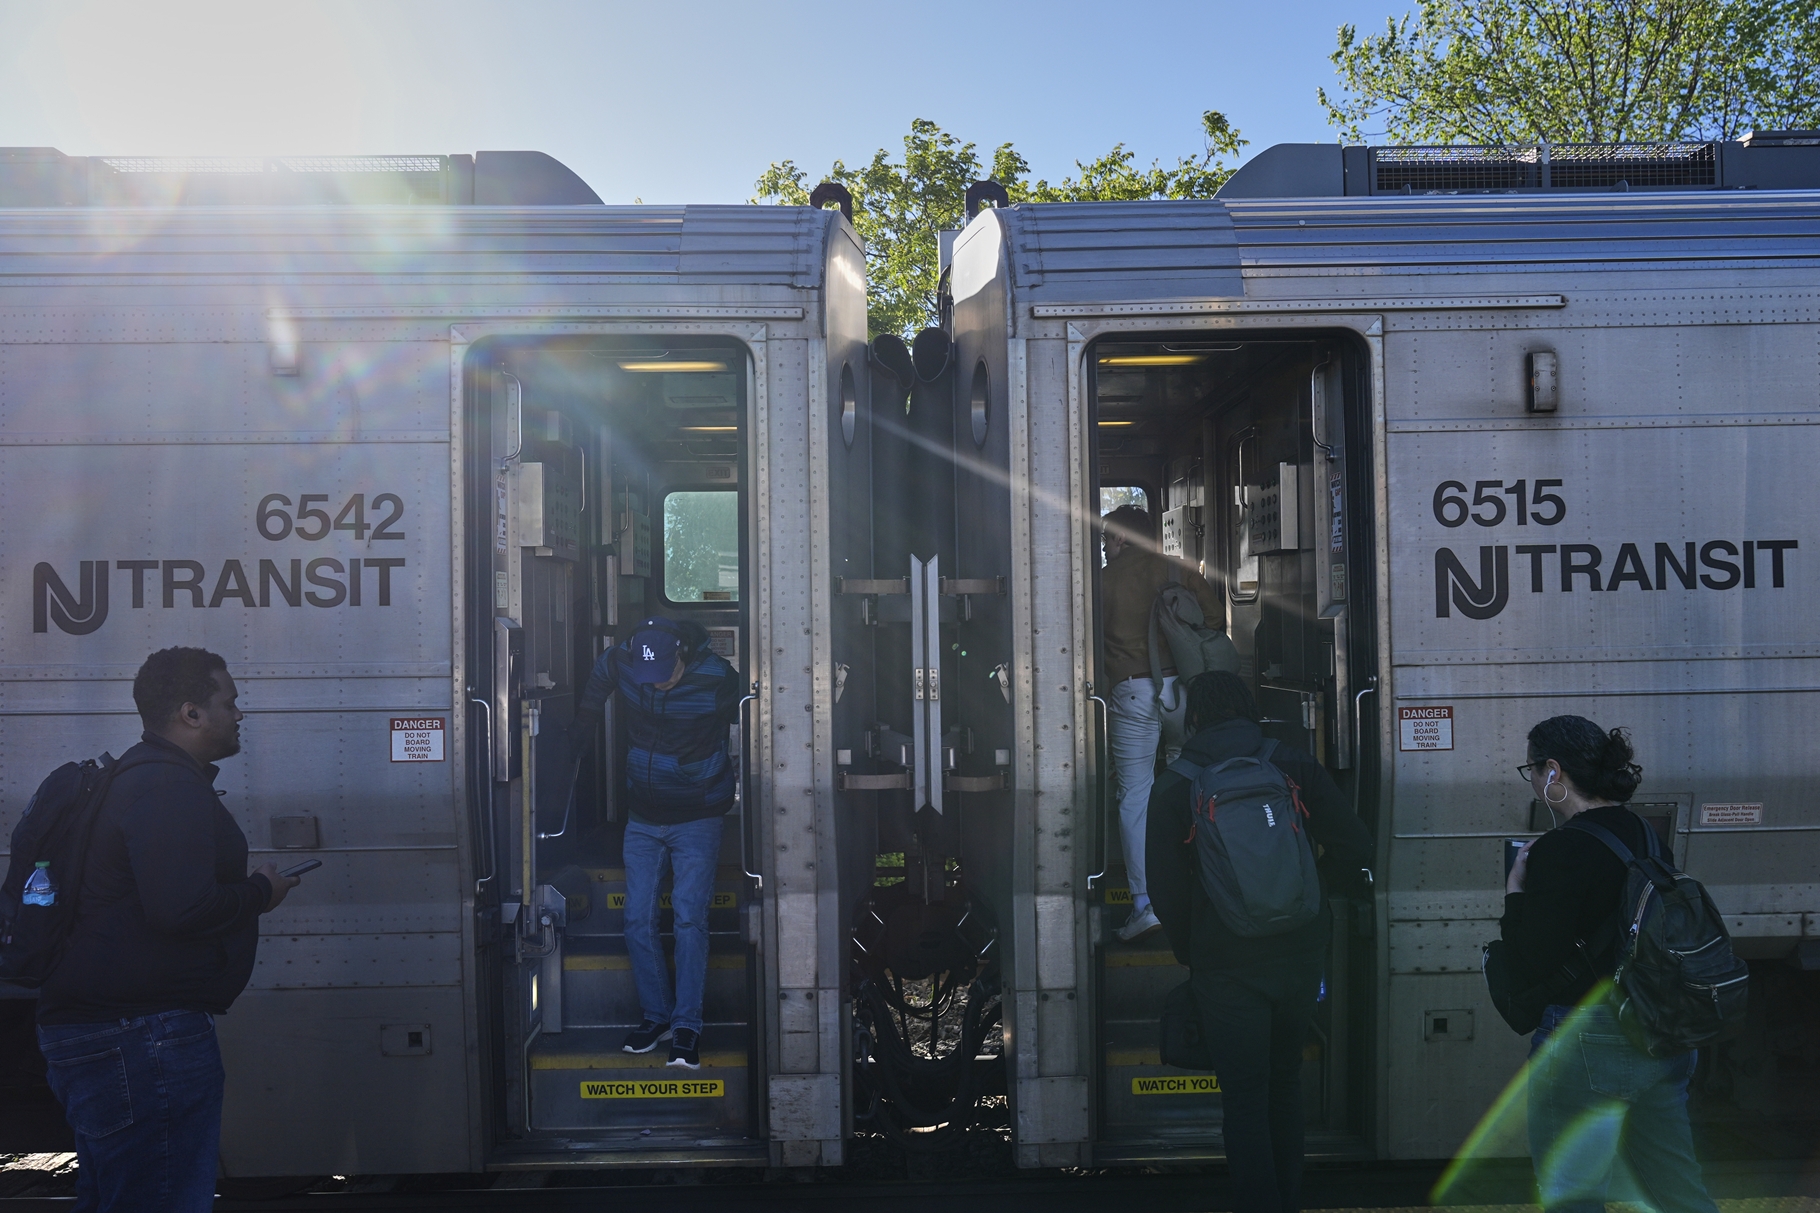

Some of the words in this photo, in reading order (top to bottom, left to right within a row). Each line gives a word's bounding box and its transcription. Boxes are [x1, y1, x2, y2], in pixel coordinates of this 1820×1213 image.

[1432, 479, 1566, 528] 6515
[256, 492, 405, 541] 6542
[1434, 545, 1508, 620] NJ
[1514, 540, 1797, 592] TRANSIT
[33, 560, 109, 635] NJ
[117, 557, 406, 608] TRANSIT
[642, 644, 656, 661] LA
[1402, 708, 1449, 718] DANGER
[394, 720, 441, 729] DANGER
[714, 895, 731, 905] EP
[586, 1084, 635, 1095] WATCH
[639, 1083, 678, 1094] YOUR
[682, 1083, 718, 1094] STEP
[1138, 1079, 1186, 1091] WATCH
[1190, 1078, 1218, 1090] YOU
